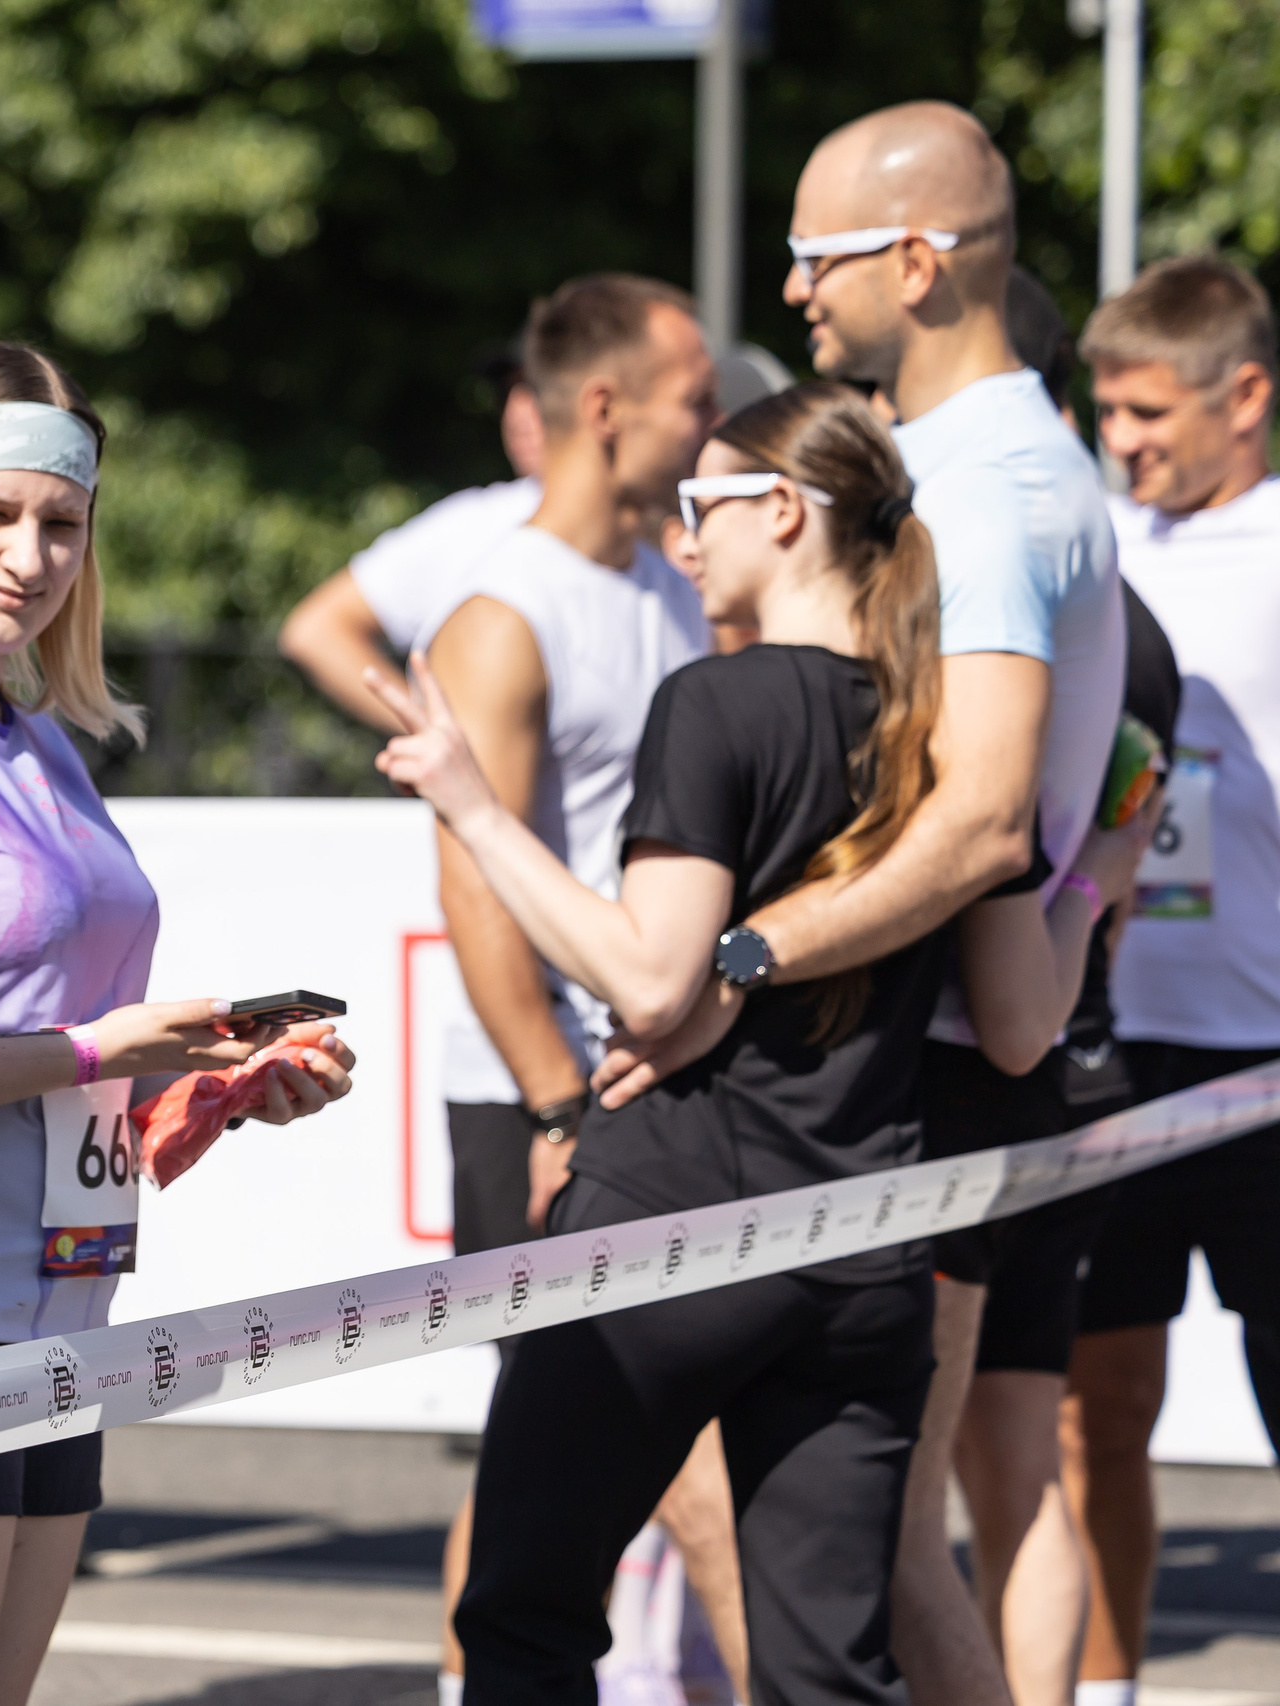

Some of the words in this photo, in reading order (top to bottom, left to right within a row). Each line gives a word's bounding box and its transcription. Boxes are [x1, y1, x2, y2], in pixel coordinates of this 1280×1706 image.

[76, 1114, 140, 1189] 66
[196, 1350, 229, 1368] runc.run
[97, 1370, 132, 1389] runc.run
